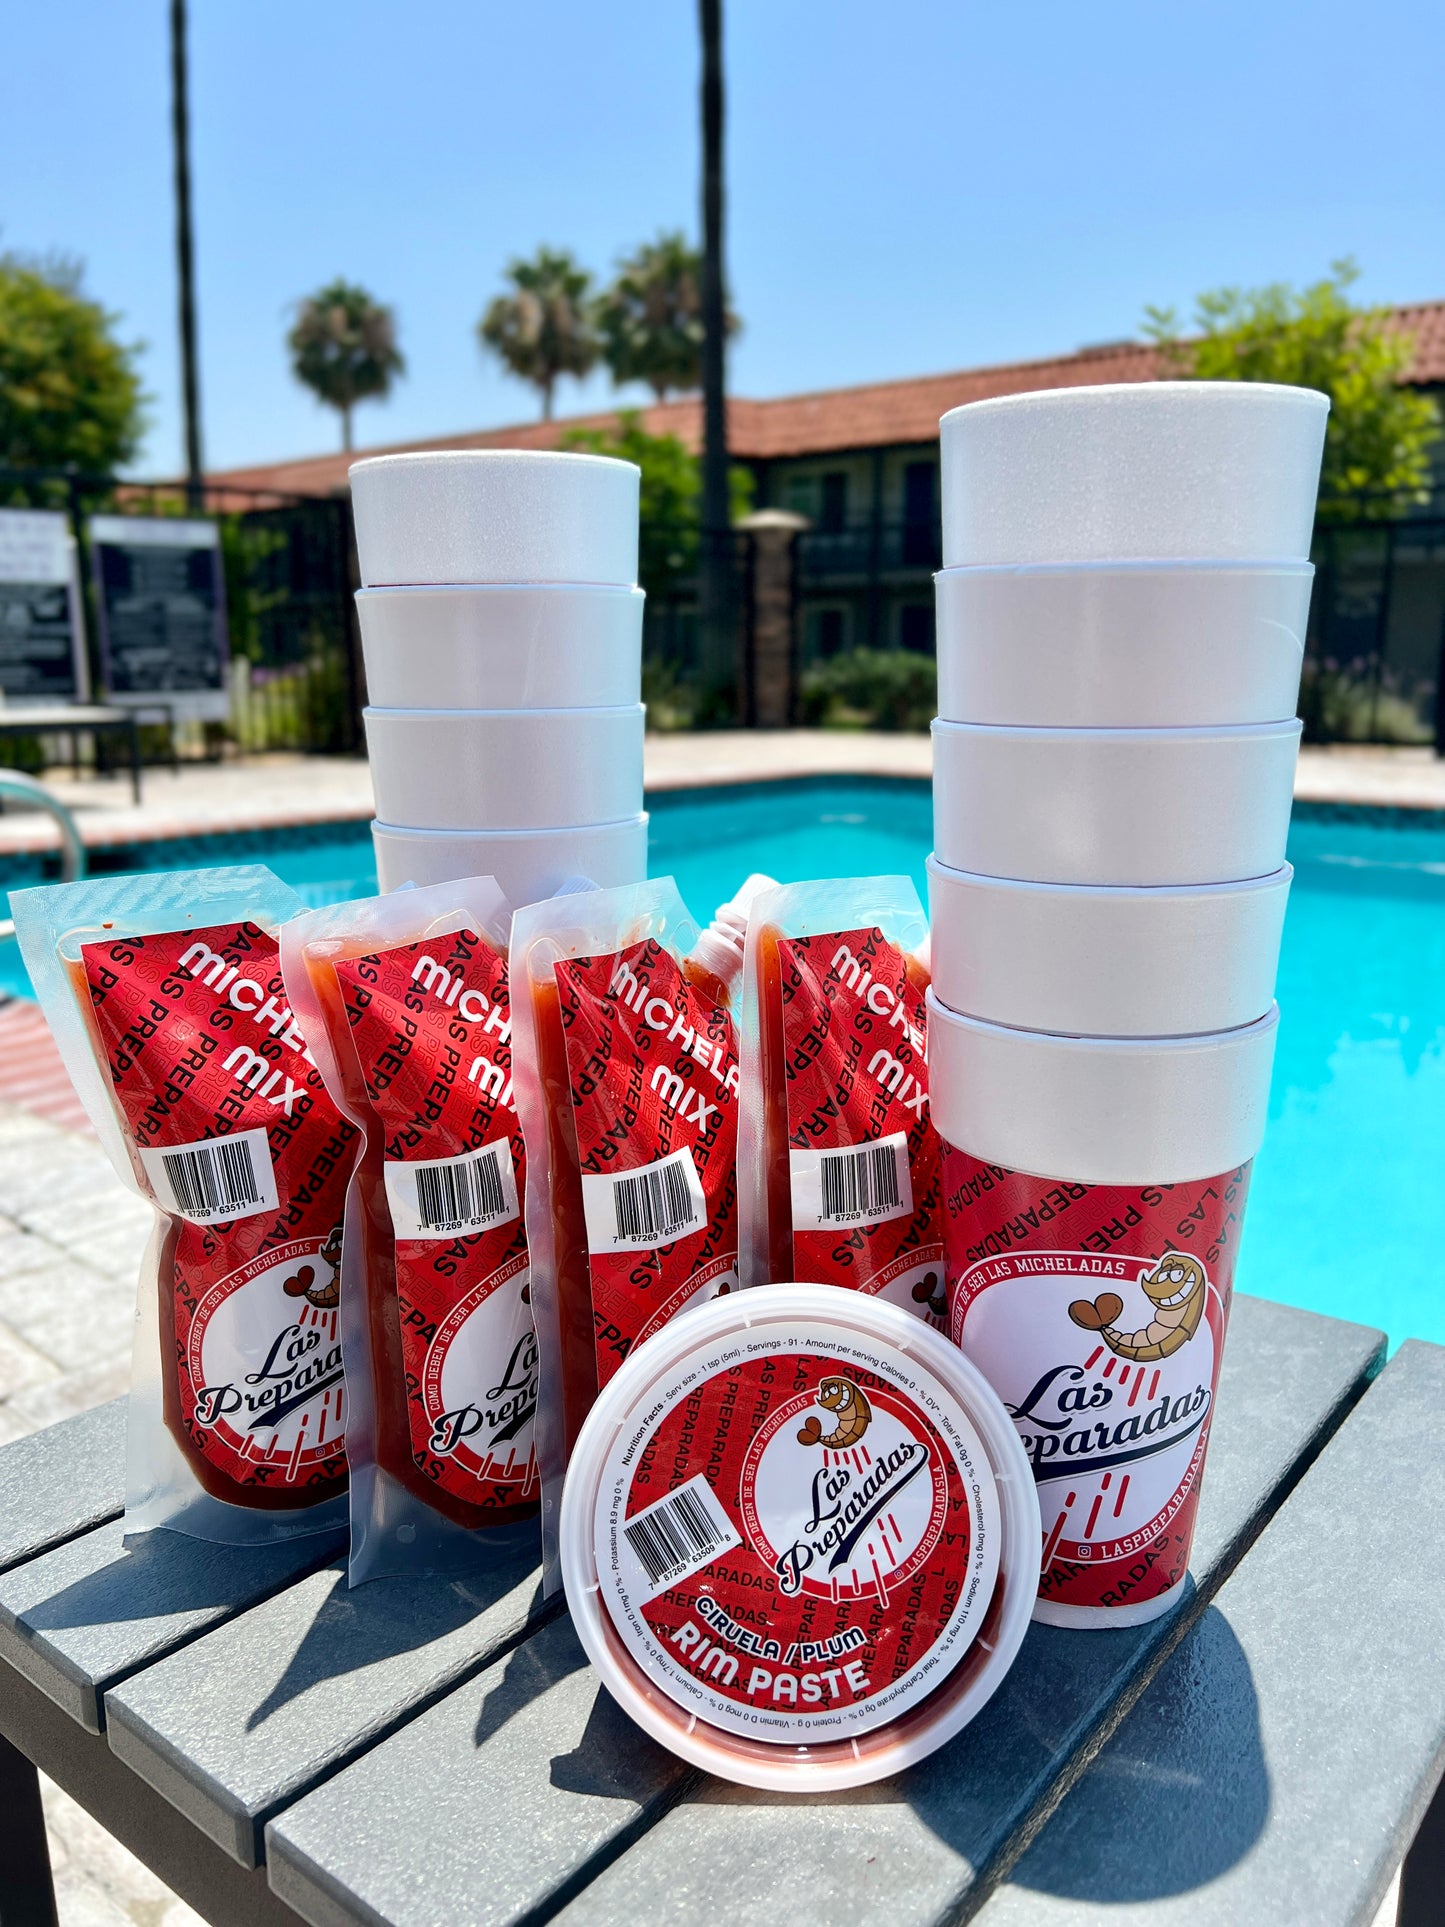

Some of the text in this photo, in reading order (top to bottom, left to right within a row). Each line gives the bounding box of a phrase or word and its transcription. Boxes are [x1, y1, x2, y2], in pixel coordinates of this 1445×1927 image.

[220, 1045, 309, 1118] MIX
[867, 1049, 930, 1122] MIX
[651, 1064, 718, 1135] MIX
[219, 1202, 246, 1214] 63511
[835, 1212, 861, 1222] 87269
[868, 1205, 891, 1217] 63511
[435, 1220, 462, 1232] 87269
[470, 1213, 496, 1226] 63511
[631, 1232, 658, 1242] 87269
[664, 1223, 685, 1237] 63511
[694, 1215, 698, 1223] 1
[882, 1248, 935, 1282] MICHELADAS
[661, 1299, 680, 1318] LAS
[680, 1259, 728, 1298] MICHELADAS
[960, 1285, 971, 1305] DE
[967, 1271, 987, 1292] SER
[986, 1261, 1012, 1280] LAS
[1015, 1257, 1127, 1276] MICHELADAS
[468, 1285, 489, 1308] LAS
[192, 1242, 311, 1382] COMO DEBEN DE SER LAS MICHELADAS
[450, 1306, 470, 1327] SER
[440, 1328, 453, 1345] DE
[805, 1339, 836, 1350] Amount
[747, 1339, 781, 1352] Servings
[837, 1344, 851, 1354] per
[245, 1325, 320, 1384] Las
[429, 1346, 445, 1379] DEBEN
[720, 1349, 741, 1363] (5ml)
[852, 1350, 879, 1367] serving
[707, 1358, 720, 1369] tsp
[683, 1372, 697, 1387] size
[880, 1361, 909, 1385] Calories
[665, 1385, 682, 1400] Serv
[909, 1381, 916, 1389] 0
[430, 1382, 441, 1411] COMO
[920, 1390, 927, 1400] %
[1003, 1365, 1114, 1431] Las
[643, 1402, 664, 1427] Facts
[941, 1416, 955, 1435] Total
[622, 1426, 647, 1466] Nutrition
[953, 1435, 964, 1449] Fat
[960, 1450, 968, 1461] 0g
[744, 1397, 808, 1560] COMO DEBEN DE SER LAS MICHELADAS
[968, 1468, 976, 1478] %
[616, 1478, 624, 1487] %
[614, 1495, 623, 1509] mg
[804, 1467, 850, 1533] Las
[972, 1484, 985, 1531] Cholesterol
[610, 1511, 618, 1524] 8.9
[776, 1442, 921, 1594] Preparadas
[906, 1465, 946, 1571] LASPREPARADASLA
[611, 1526, 620, 1571] Potassium
[976, 1532, 985, 1552] 0mg
[648, 1534, 731, 1590] 7 87269 63509 8
[975, 1561, 983, 1570] %
[615, 1577, 622, 1587] %
[966, 1577, 980, 1608] Sodium
[621, 1594, 635, 1621] 0.1mg
[957, 1610, 969, 1624] 110
[632, 1620, 644, 1637] Iron
[697, 1597, 780, 1660] CIRUELA
[784, 1645, 796, 1664] /
[802, 1628, 866, 1661] PLUM
[949, 1626, 960, 1636] mg
[643, 1641, 651, 1651] %
[940, 1644, 950, 1652] %
[655, 1654, 675, 1677] 1.7mg
[670, 1620, 871, 1703] RIM PASTE
[922, 1656, 939, 1672] Total
[675, 1674, 703, 1699] Calcium
[877, 1671, 923, 1707] Carbohydrate
[709, 1698, 716, 1707] %
[718, 1703, 724, 1711] 0
[865, 1705, 876, 1713] 0g
[725, 1706, 742, 1717] mcg
[743, 1713, 749, 1721] 0
[751, 1715, 758, 1723] D
[848, 1712, 858, 1720] %
[858, 1709, 865, 1717] 0
[760, 1715, 790, 1728] Vitamin
[805, 1720, 811, 1728] 0
[813, 1718, 842, 1727] Protein
